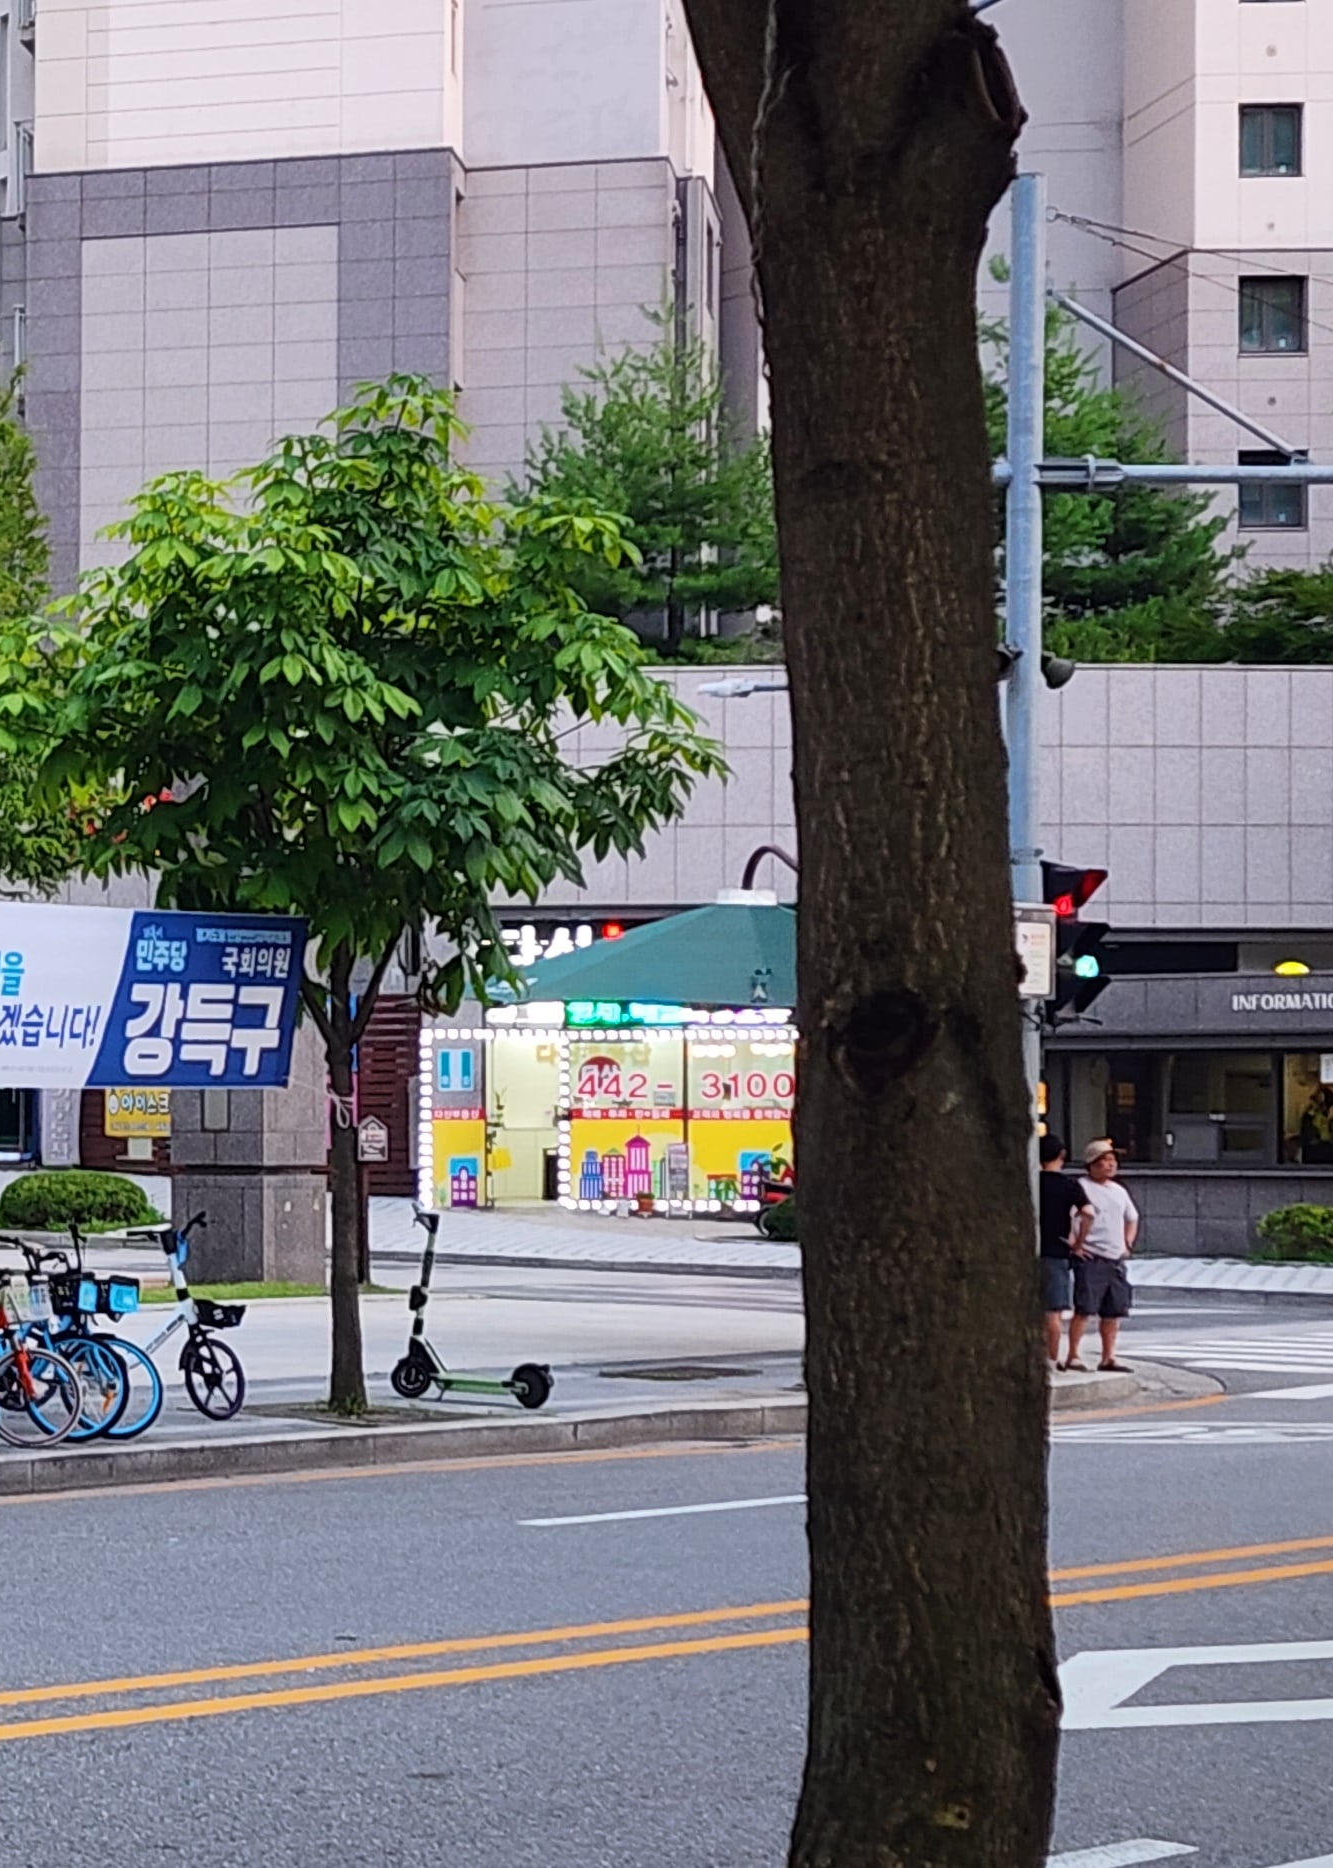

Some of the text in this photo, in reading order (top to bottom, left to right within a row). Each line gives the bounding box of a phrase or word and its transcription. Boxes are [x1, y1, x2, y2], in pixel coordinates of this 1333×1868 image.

[136, 939, 187, 972] 민주당
[221, 946, 292, 979] 국회의원
[123, 982, 285, 1077] 강득구
[701, 1072, 795, 1099] 3100
